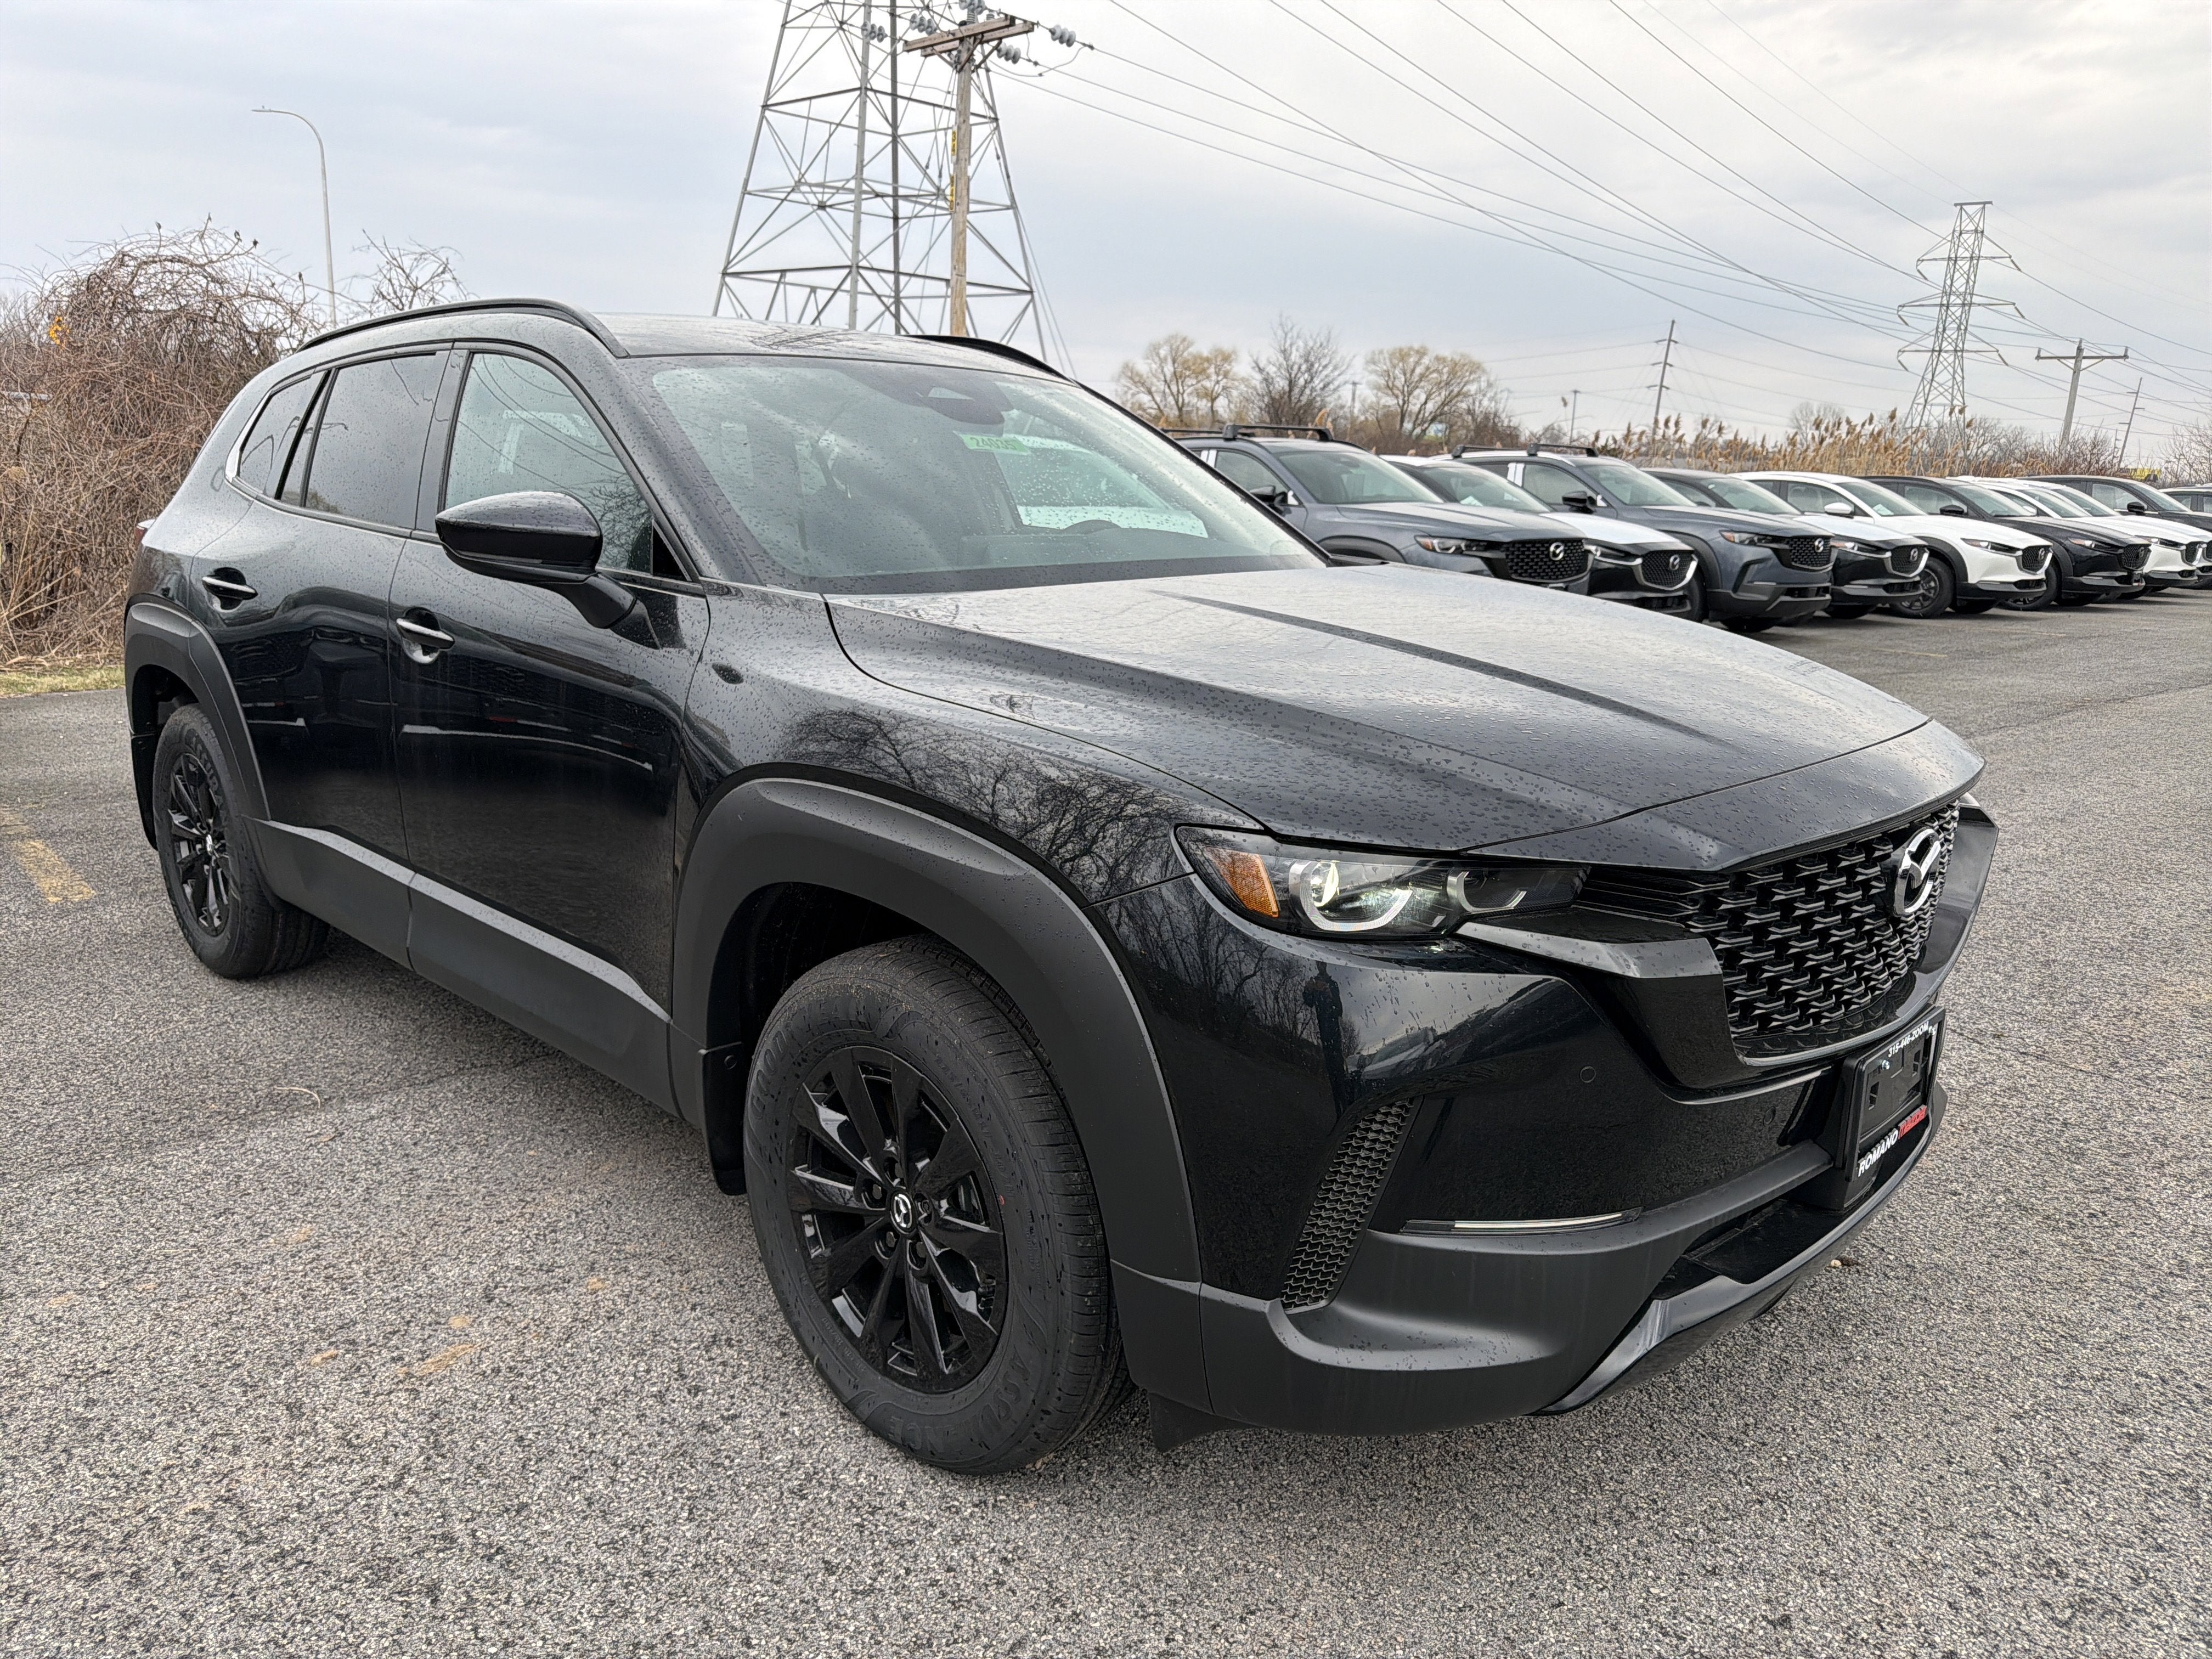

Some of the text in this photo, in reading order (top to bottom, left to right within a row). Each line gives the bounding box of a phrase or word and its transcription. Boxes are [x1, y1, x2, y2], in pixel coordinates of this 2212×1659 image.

[970, 437, 1017, 450] 24035
[1888, 1020, 1929, 1058] 315-446-ZOOM
[1858, 1128, 1898, 1177] ROMANO
